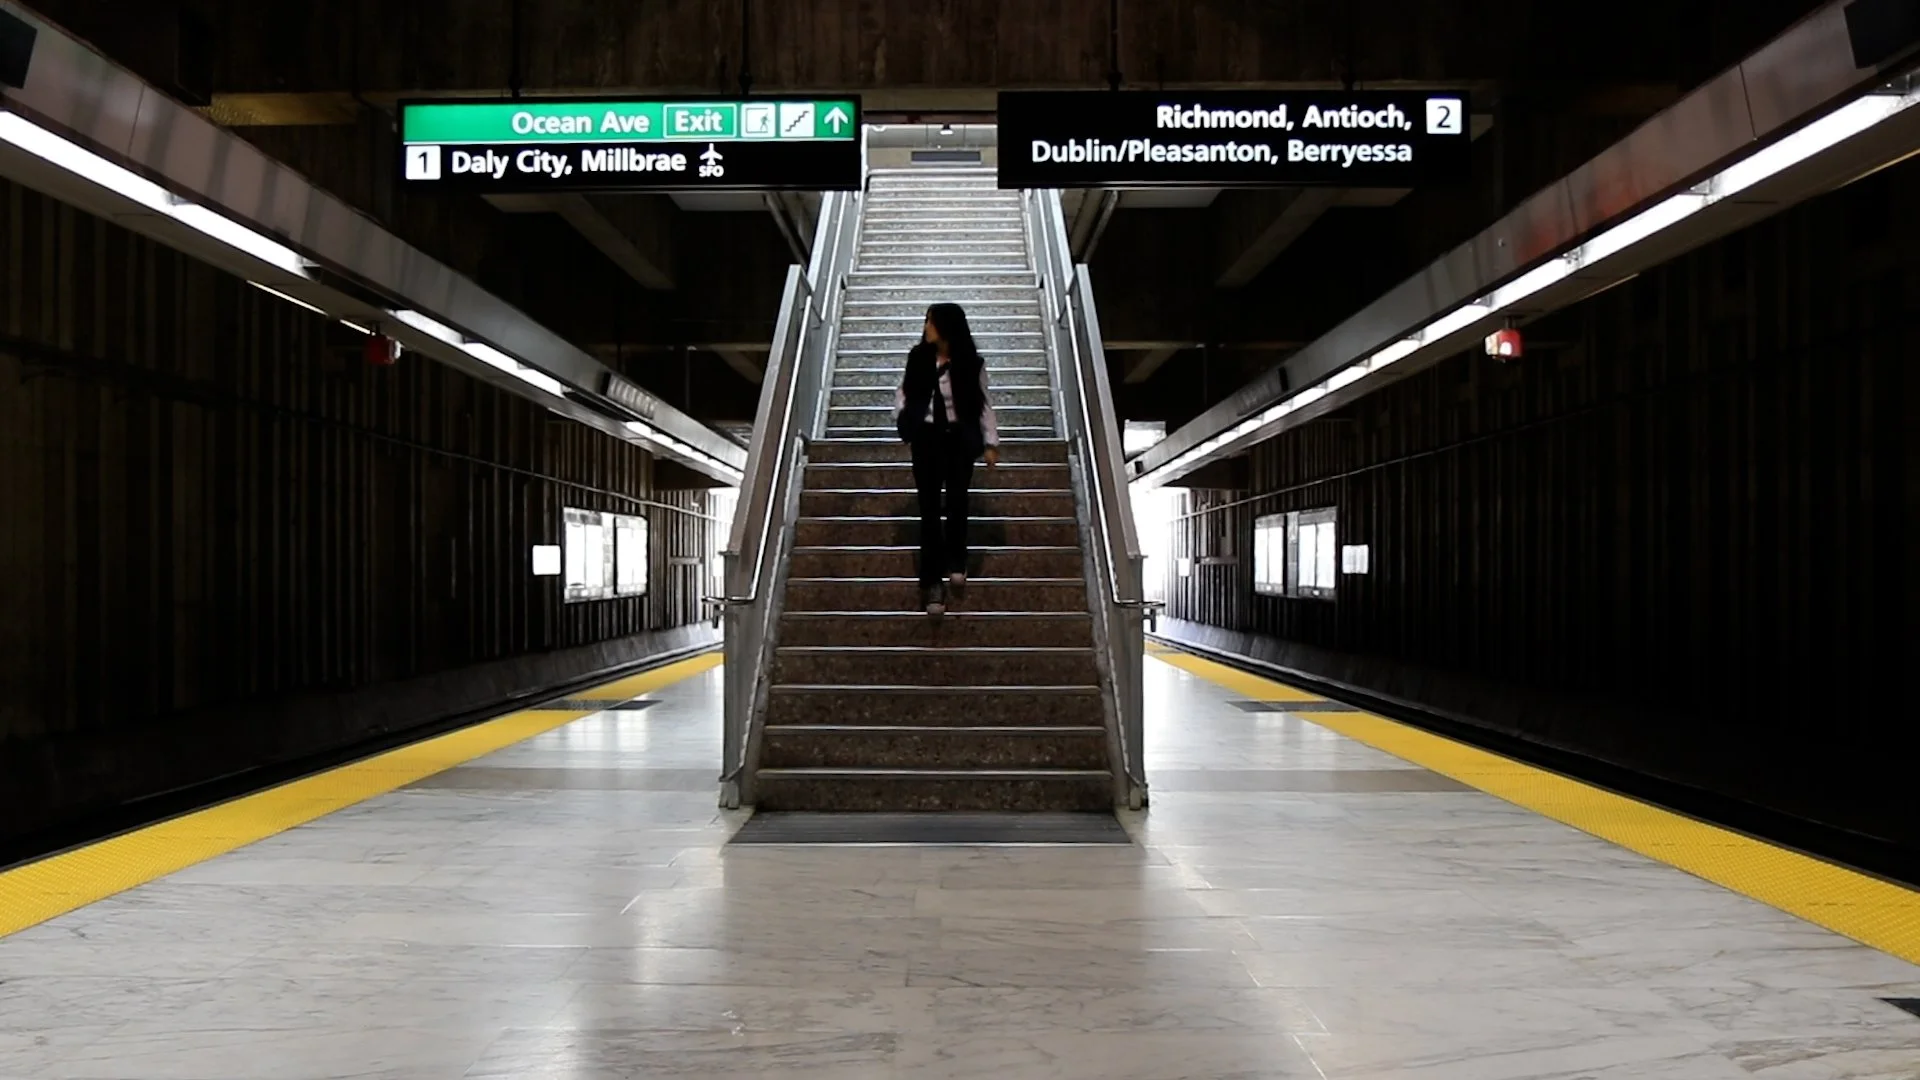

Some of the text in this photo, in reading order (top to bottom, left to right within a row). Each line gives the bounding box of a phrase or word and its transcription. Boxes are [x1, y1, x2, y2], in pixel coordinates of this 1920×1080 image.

[511, 109, 723, 134] Ocean Ave Exit
[1157, 104, 1452, 131] Richmond, Antioch, 2
[418, 147, 687, 179] 1 Daly City, Millbrae
[1032, 139, 1412, 168] Dublin/Pleasanton, Berryessa
[698, 163, 725, 178] SFO
